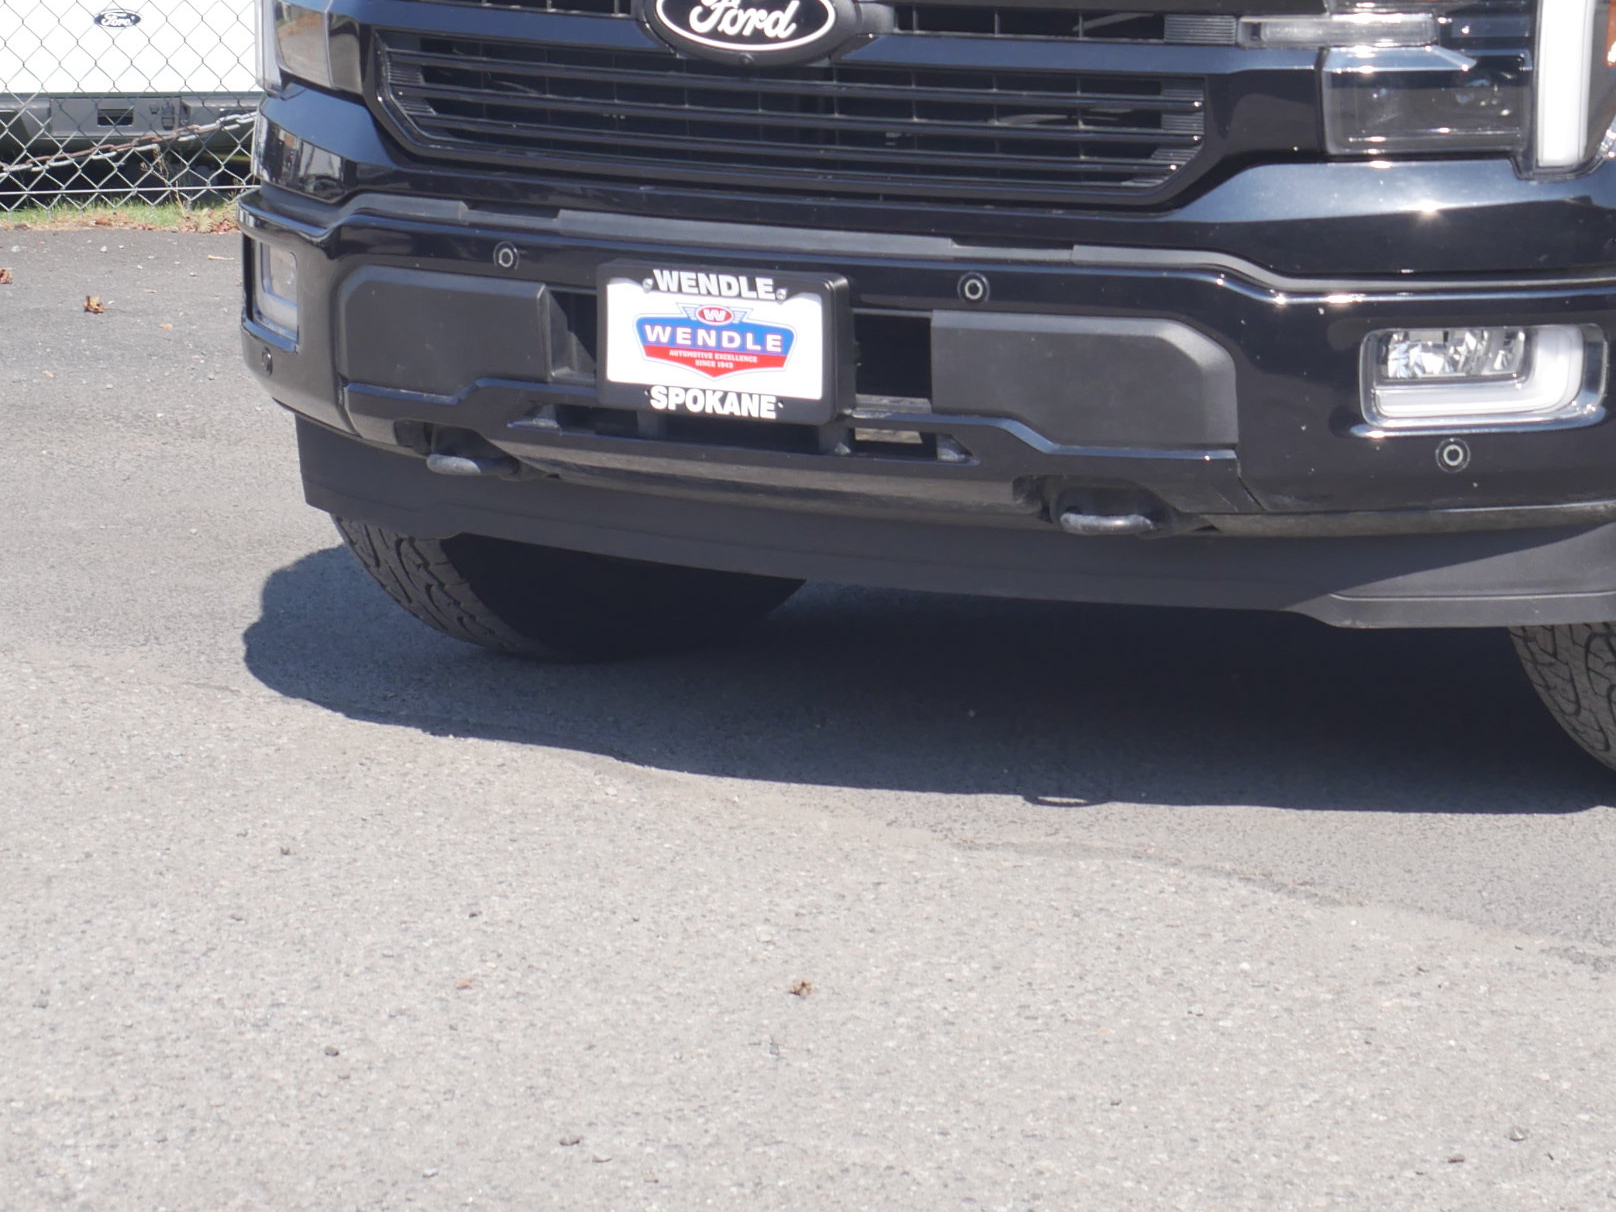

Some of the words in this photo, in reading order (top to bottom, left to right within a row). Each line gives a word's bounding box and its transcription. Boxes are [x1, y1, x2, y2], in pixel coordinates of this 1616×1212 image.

[653, 269, 776, 300] WENDLE
[703, 309, 726, 321] W
[643, 325, 782, 352] WENDLE
[669, 349, 713, 359] AUTOMOTIVE
[714, 353, 758, 363] EXCELLENCE
[695, 359, 716, 368] SINCE
[650, 385, 776, 419] SPOKANE
